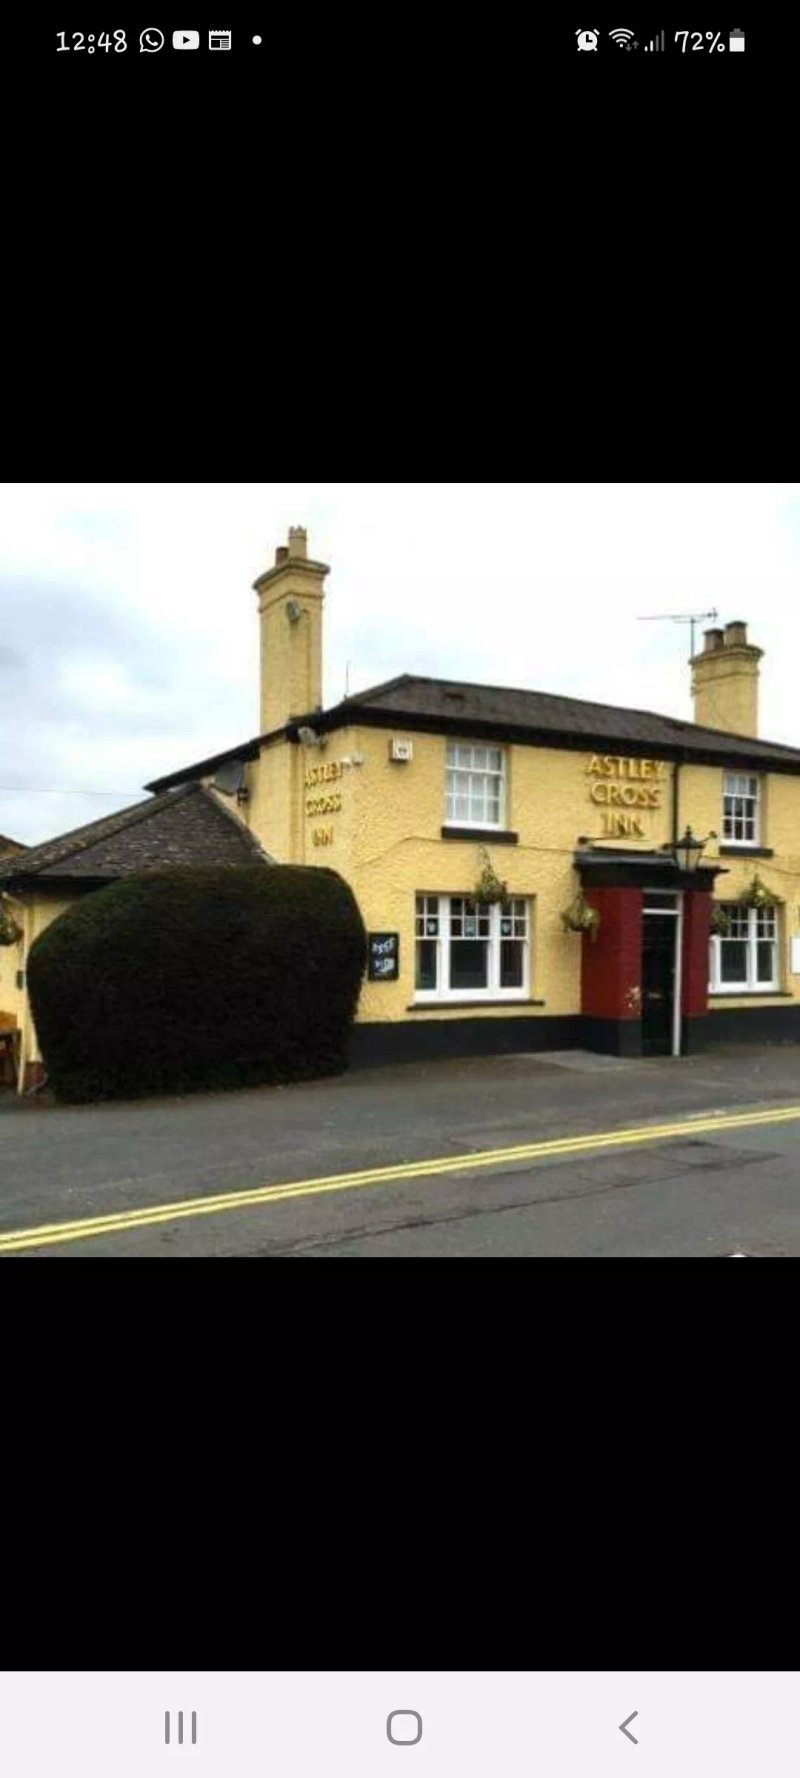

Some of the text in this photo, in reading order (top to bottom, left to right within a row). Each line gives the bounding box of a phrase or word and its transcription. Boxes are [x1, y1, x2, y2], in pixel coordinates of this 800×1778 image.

[584, 755, 664, 779] ASTLEY
[591, 782, 660, 808] CROSS
[601, 812, 649, 837] INN
